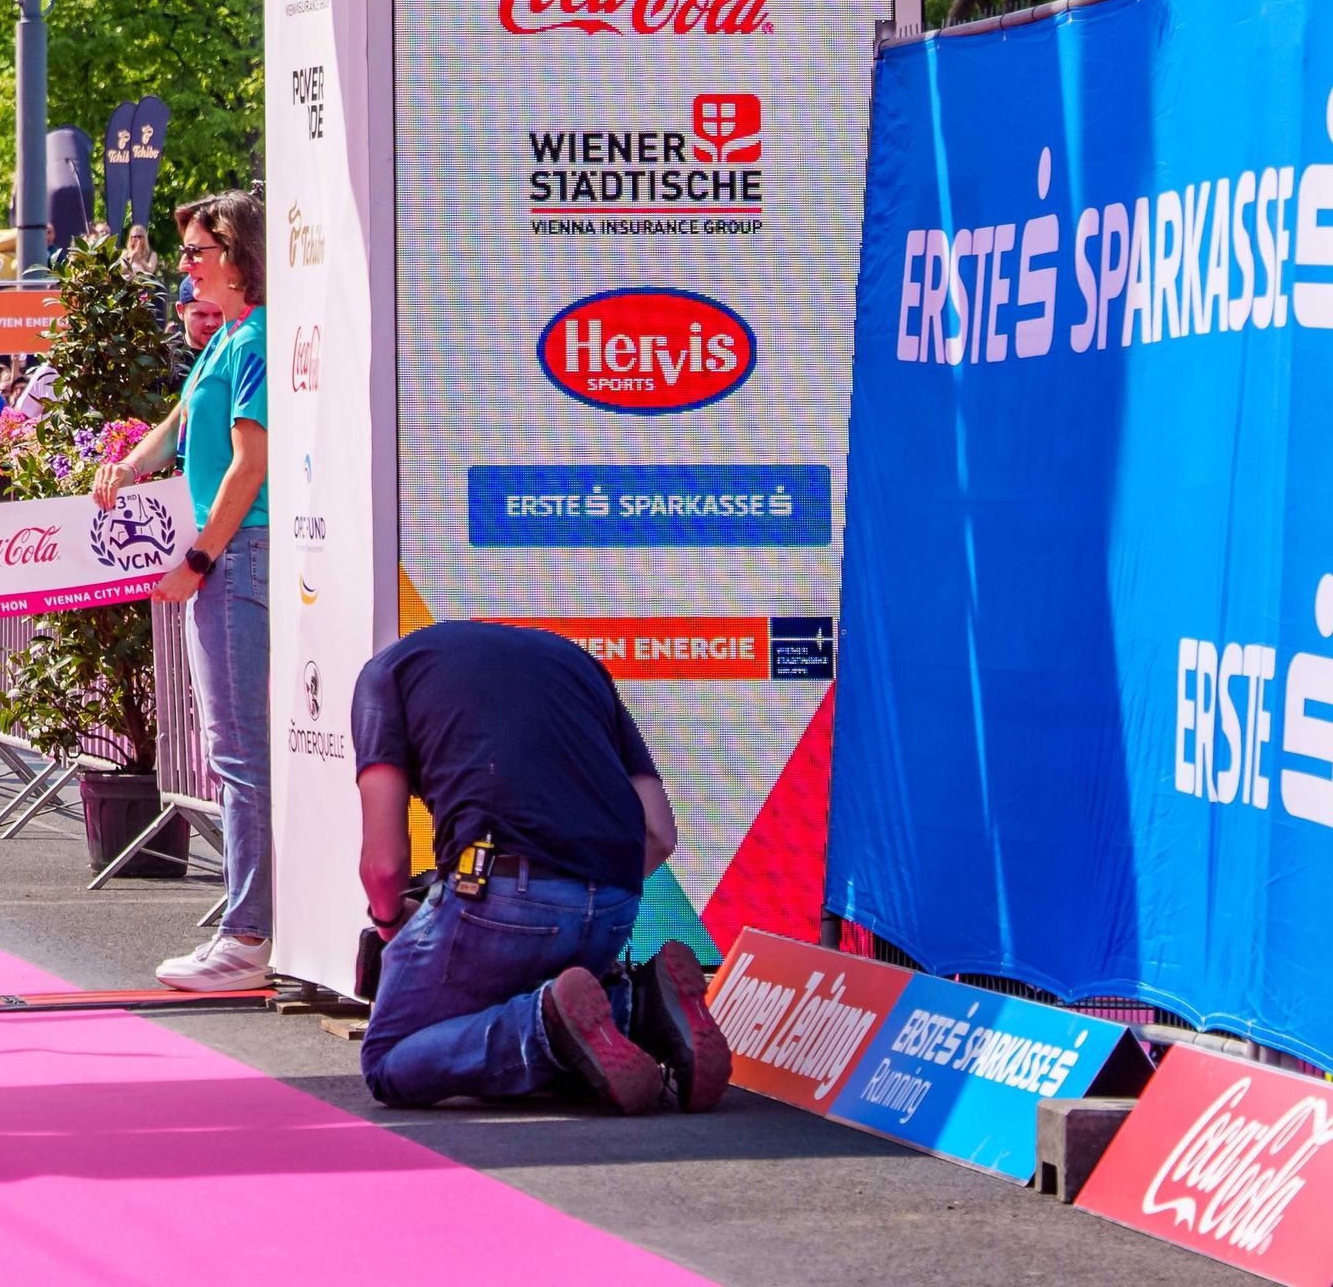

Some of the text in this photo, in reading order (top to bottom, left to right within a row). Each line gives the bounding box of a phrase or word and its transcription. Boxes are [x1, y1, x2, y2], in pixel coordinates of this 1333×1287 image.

[529, 132, 687, 164] WIENER
[529, 170, 762, 203] STÄDTISCHE
[531, 219, 763, 236] VIENNA INSURANCE GROUP
[896, 166, 1295, 366] ERSTE SPARKASSE
[564, 319, 738, 386] Hervis
[587, 378, 654, 392] SPORTS
[506, 494, 766, 517] ERSTE SPARKASSE
[117, 550, 163, 572] VCM
[44, 592, 91, 607] VIENNA
[94, 586, 121, 601] CITY
[634, 637, 756, 661] ENERGIE
[1175, 638, 1276, 810] ERSTE
[710, 952, 878, 1101] Kronen Zeitung
[890, 1008, 1056, 1095] ERSTE SPARKASSE
[861, 1057, 933, 1125] Running
